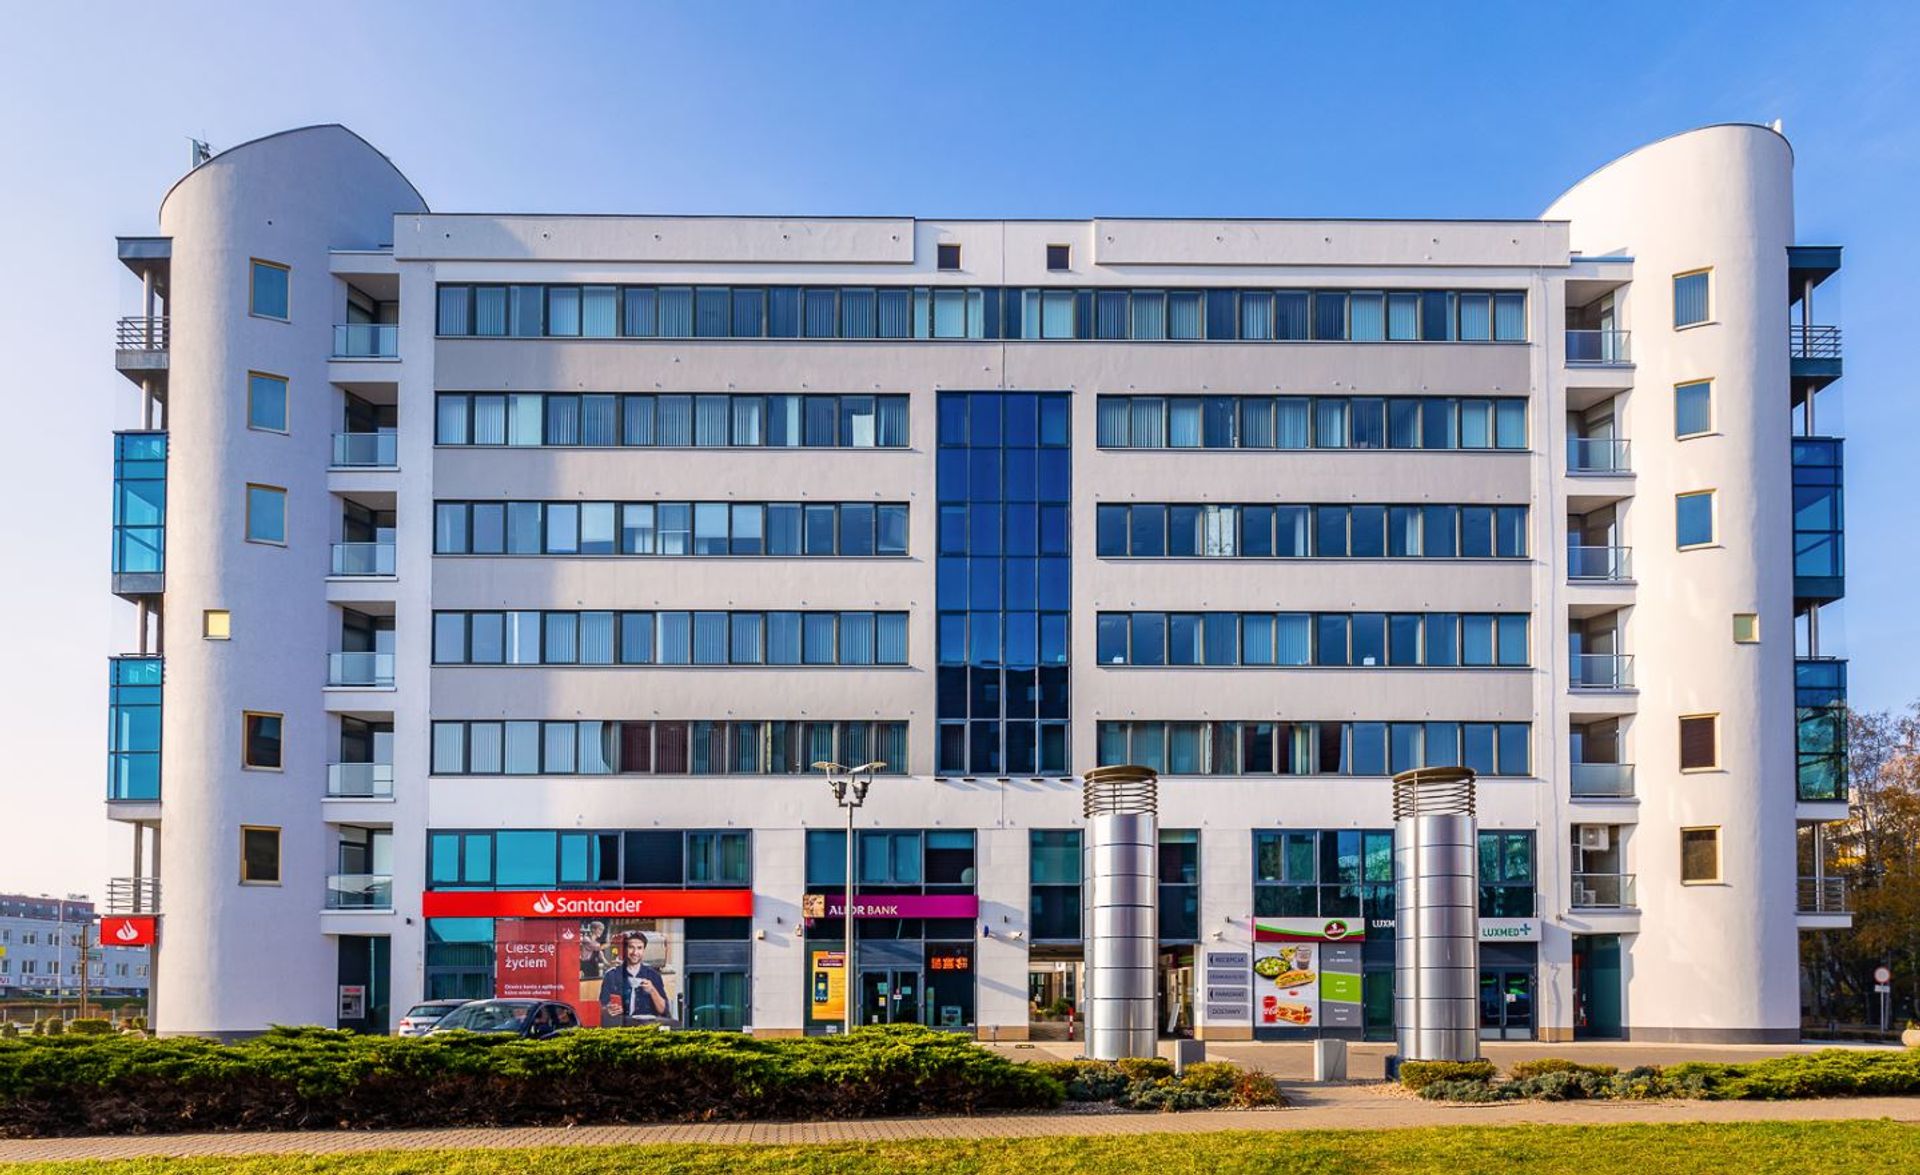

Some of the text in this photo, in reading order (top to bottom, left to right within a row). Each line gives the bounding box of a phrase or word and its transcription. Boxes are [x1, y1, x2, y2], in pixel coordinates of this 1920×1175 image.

[557, 897, 642, 913] Santander
[829, 905, 898, 915] ALOR BANK
[1372, 919, 1396, 928] LUXM
[1482, 928, 1520, 937] LUXMED
[505, 942, 556, 956] Ciesz się
[505, 958, 548, 972] życiem
